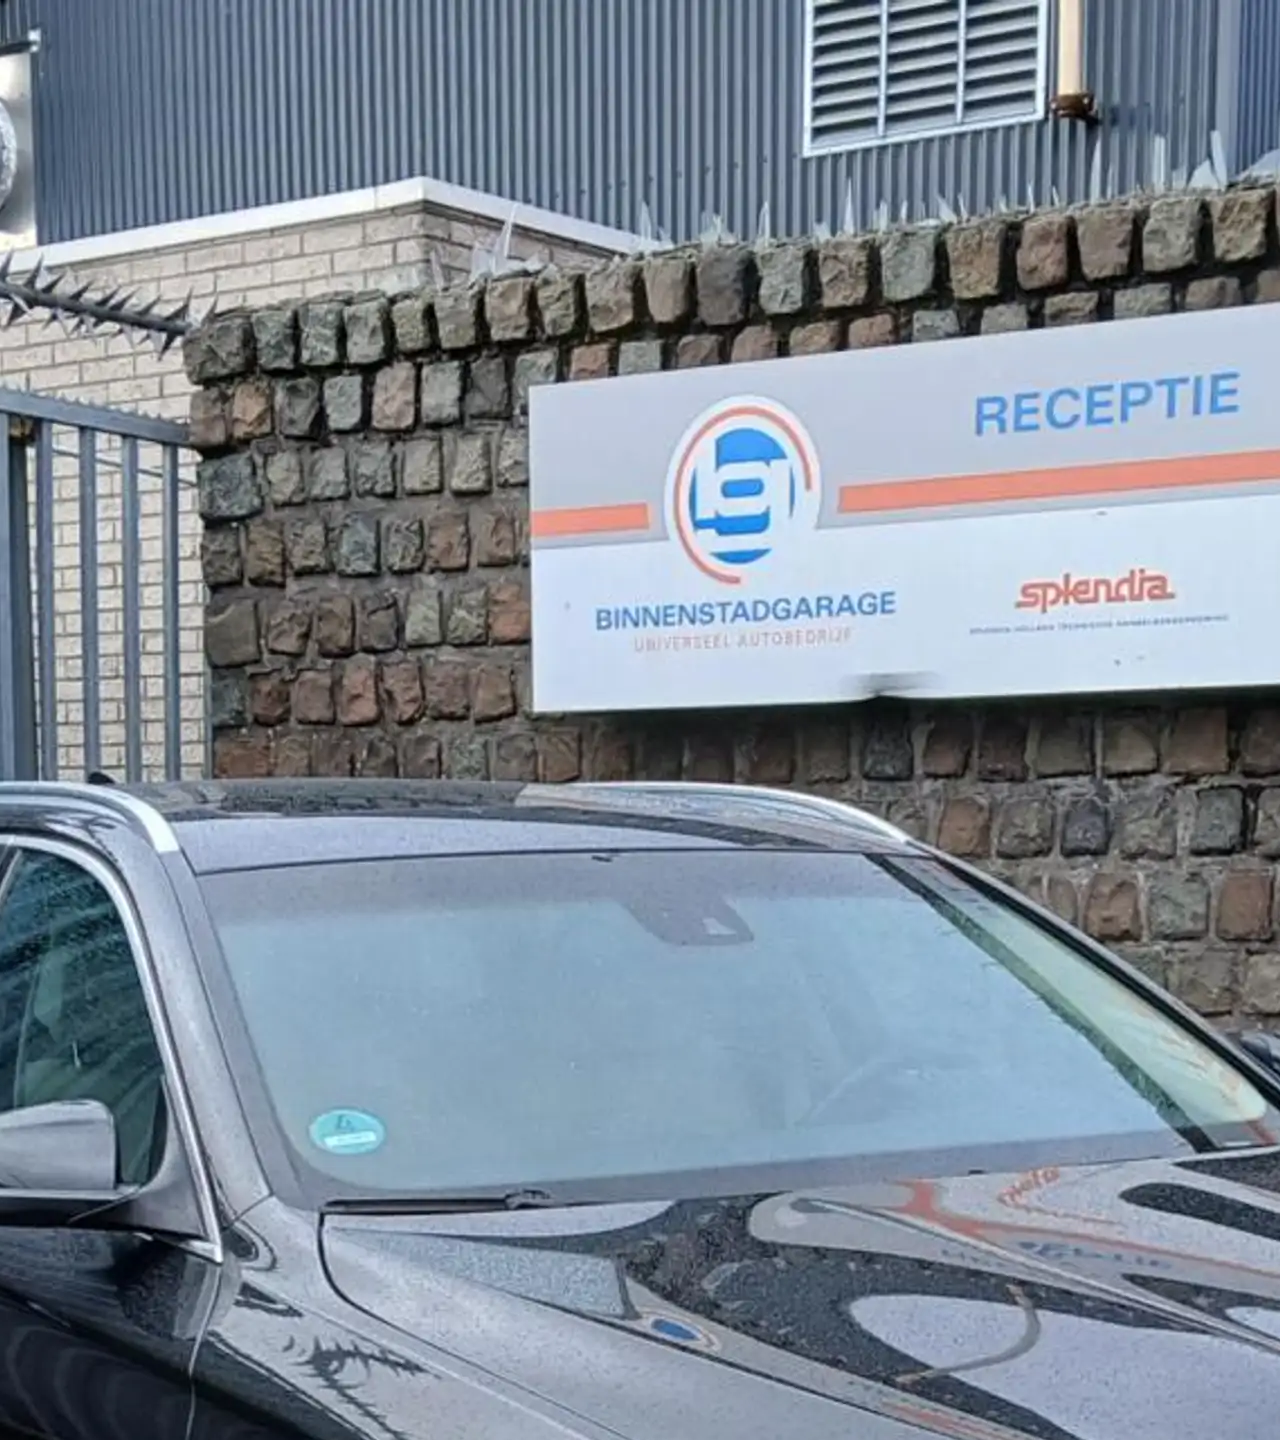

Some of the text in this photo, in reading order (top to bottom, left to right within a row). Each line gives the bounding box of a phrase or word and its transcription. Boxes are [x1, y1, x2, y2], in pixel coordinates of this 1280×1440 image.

[974, 372, 1240, 437] RECEPTIE
[595, 591, 896, 631] BINNENSTADGARAGE
[1015, 568, 1176, 614] splendia
[633, 627, 852, 653] UNIVERSEEL AUTOBEDRIJF
